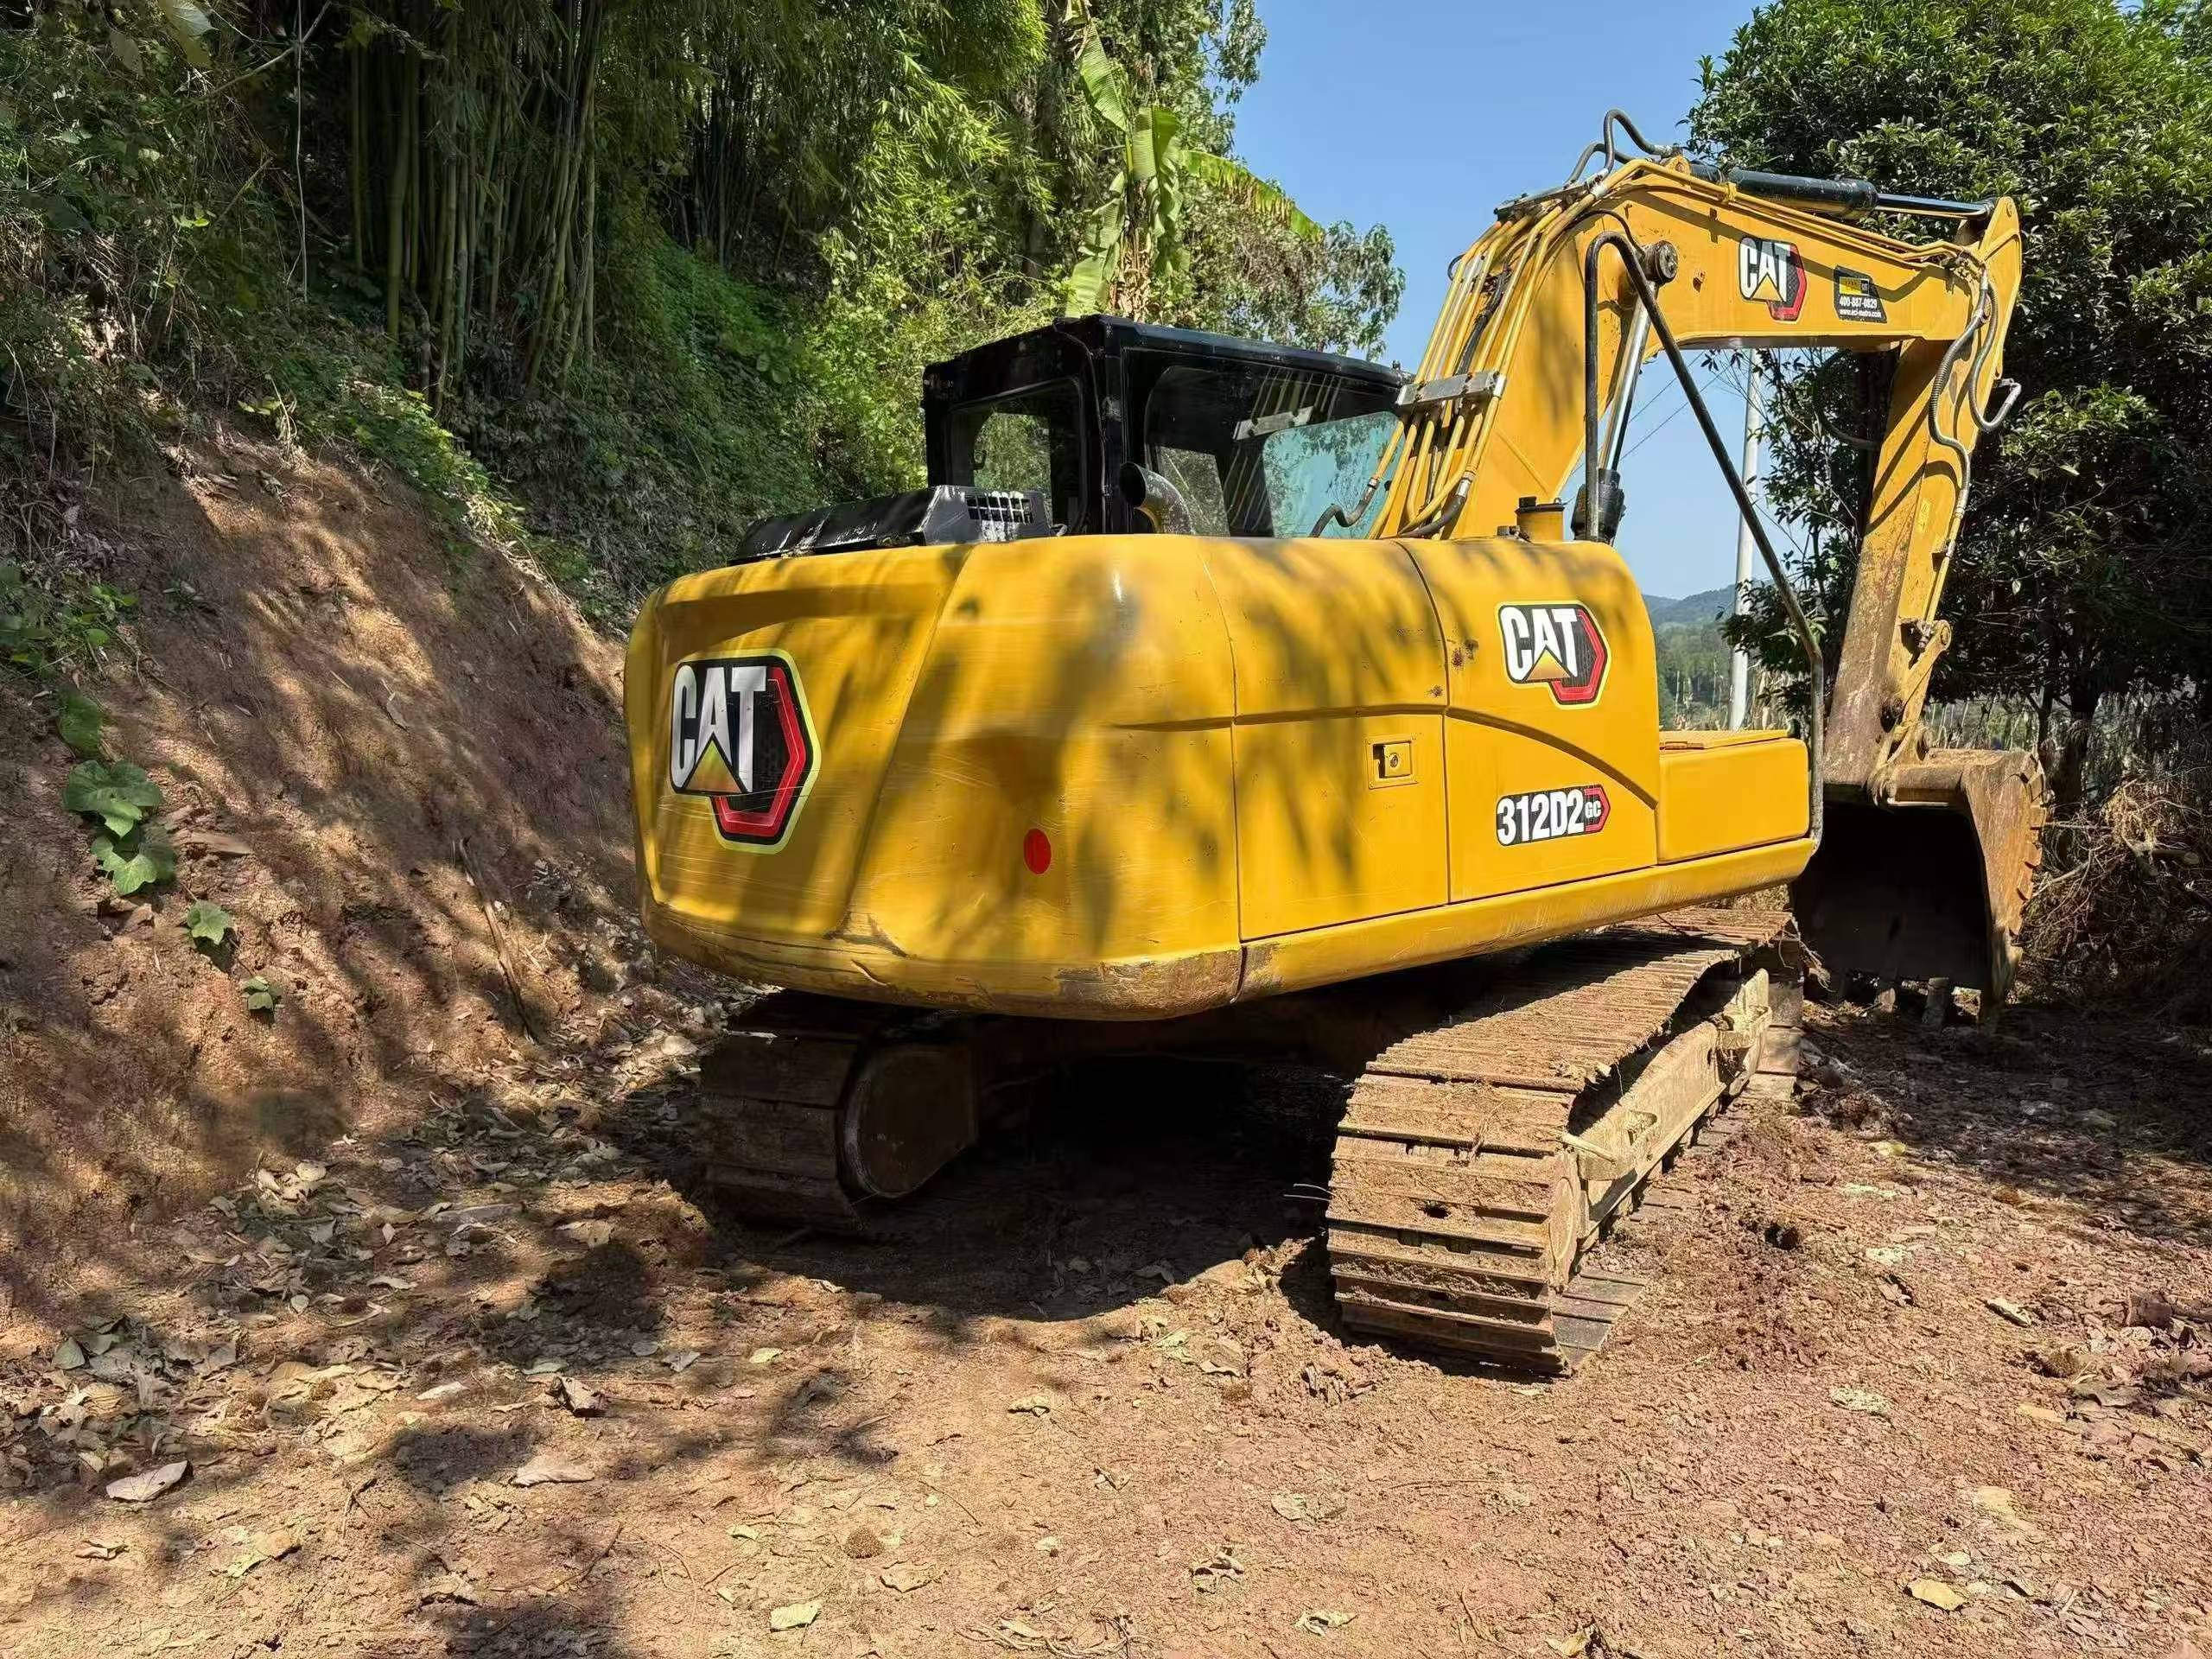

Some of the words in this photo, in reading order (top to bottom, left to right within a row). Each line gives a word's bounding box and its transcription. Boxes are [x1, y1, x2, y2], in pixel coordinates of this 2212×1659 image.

[1740, 238, 1791, 302] CAT
[1499, 607, 1578, 681] CAT
[671, 664, 767, 793] CAT
[1497, 788, 1585, 845] 312D2
[1585, 799, 1602, 818] GC
